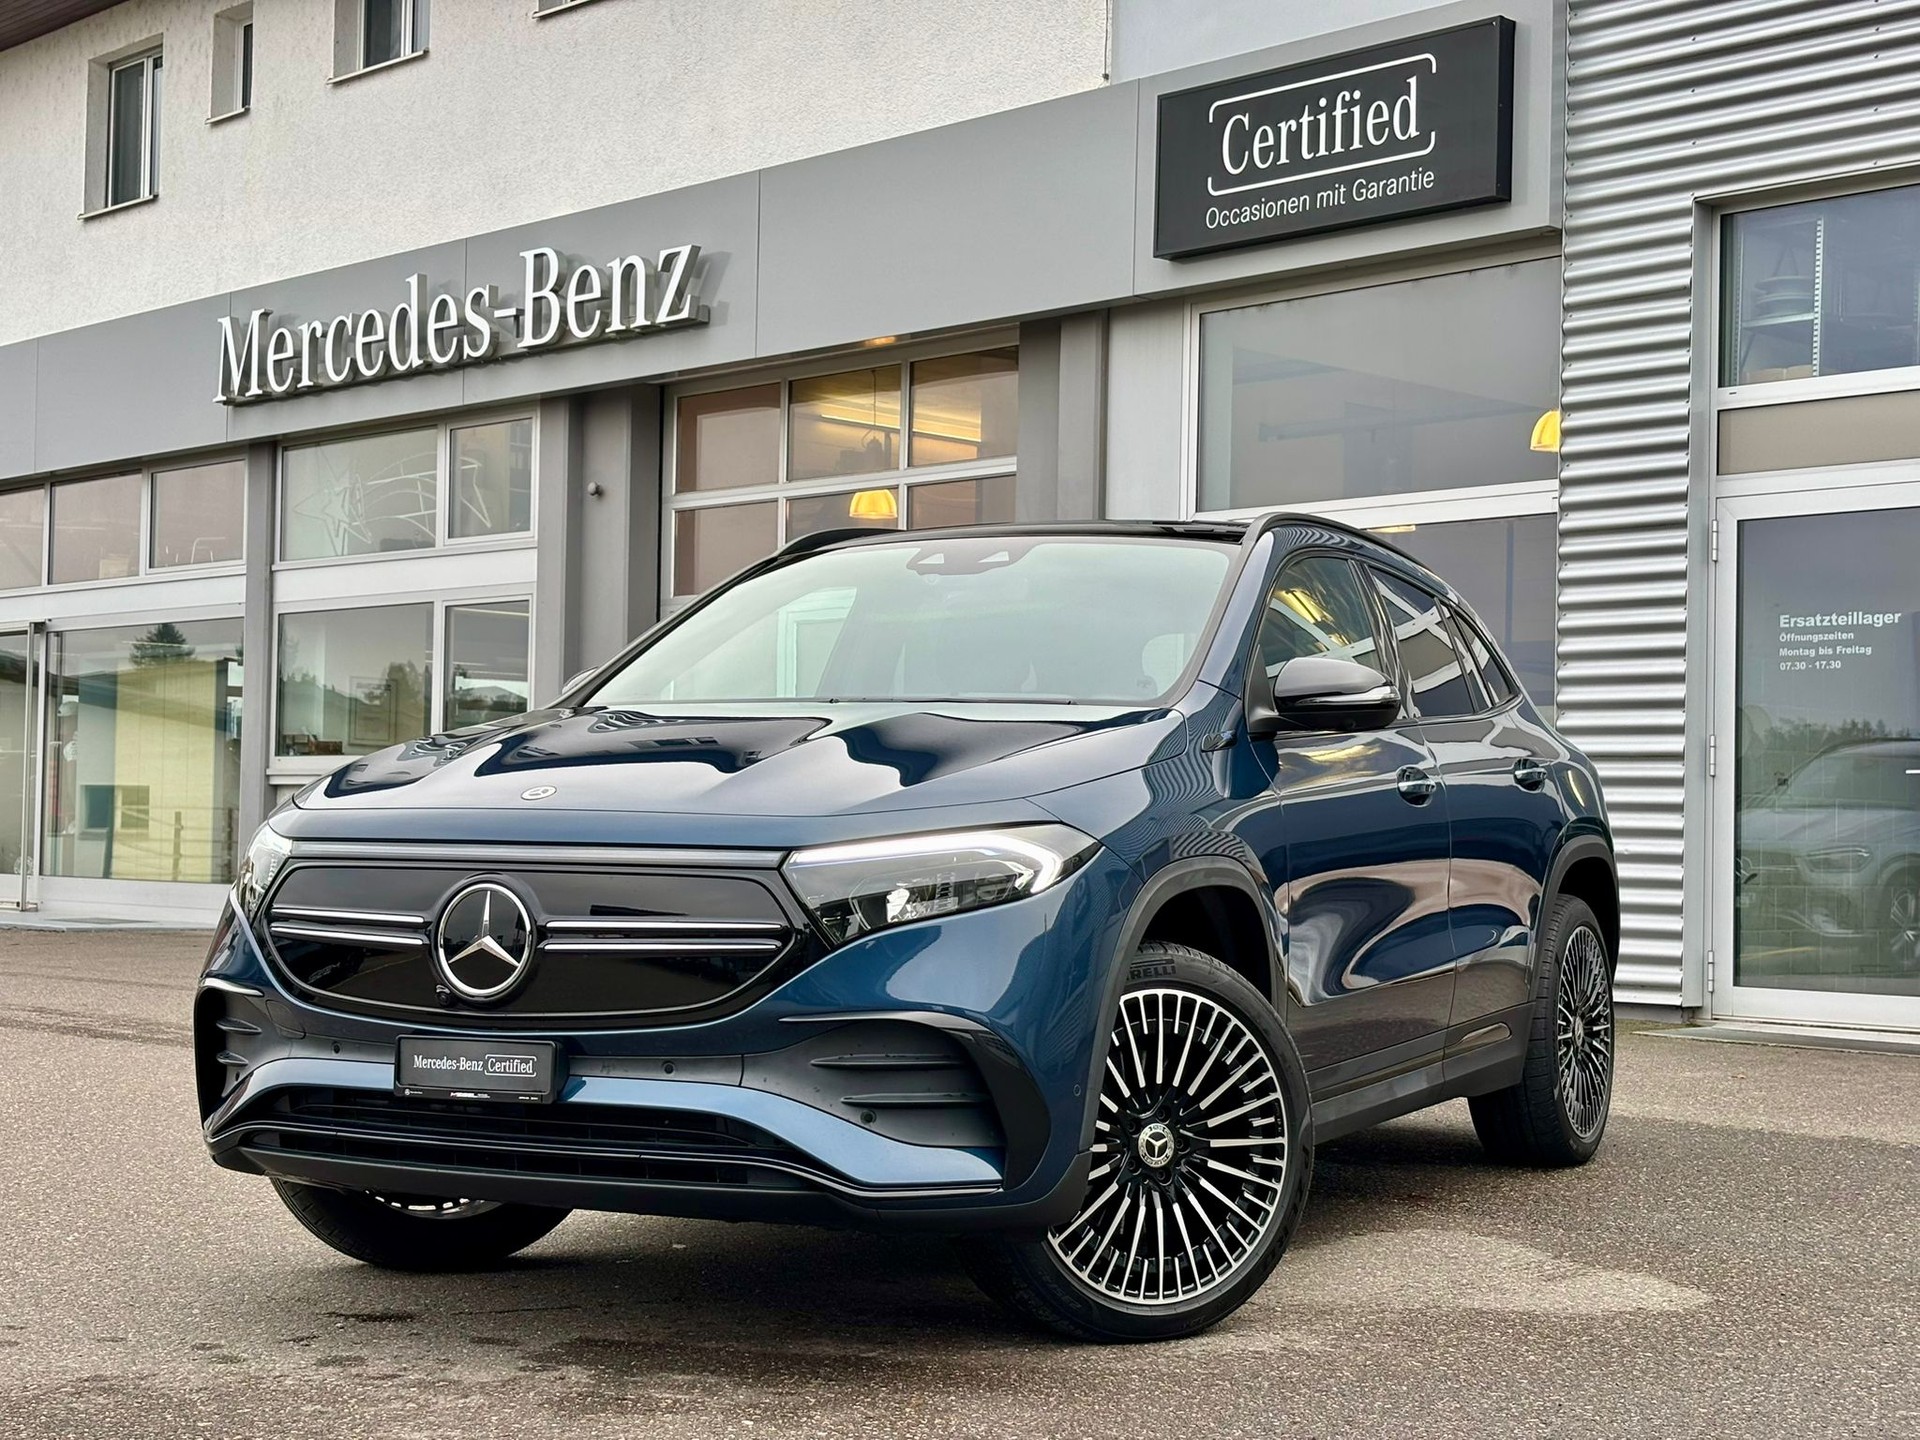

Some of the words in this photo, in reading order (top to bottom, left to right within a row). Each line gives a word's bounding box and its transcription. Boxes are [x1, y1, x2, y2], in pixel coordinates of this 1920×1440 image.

[1221, 75, 1420, 175] Certified
[1206, 194, 1310, 229] Occasionen
[1316, 183, 1346, 209] mit
[1352, 166, 1435, 201] Garantie
[213, 244, 702, 403] Mercedes-Benz
[1779, 611, 1901, 628] Ersatzteillager
[1779, 631, 1854, 643] Öffnungszeiten
[1779, 647, 1816, 657] Montag
[1818, 646, 1833, 655] bis
[1836, 645, 1872, 655] Freitag
[1779, 661, 1806, 671] 07.30
[1814, 660, 1842, 669] 17.30
[1127, 965, 1177, 981] RELLI
[413, 1054, 484, 1072] Mercedes-Benz
[487, 1058, 533, 1074] Certified
